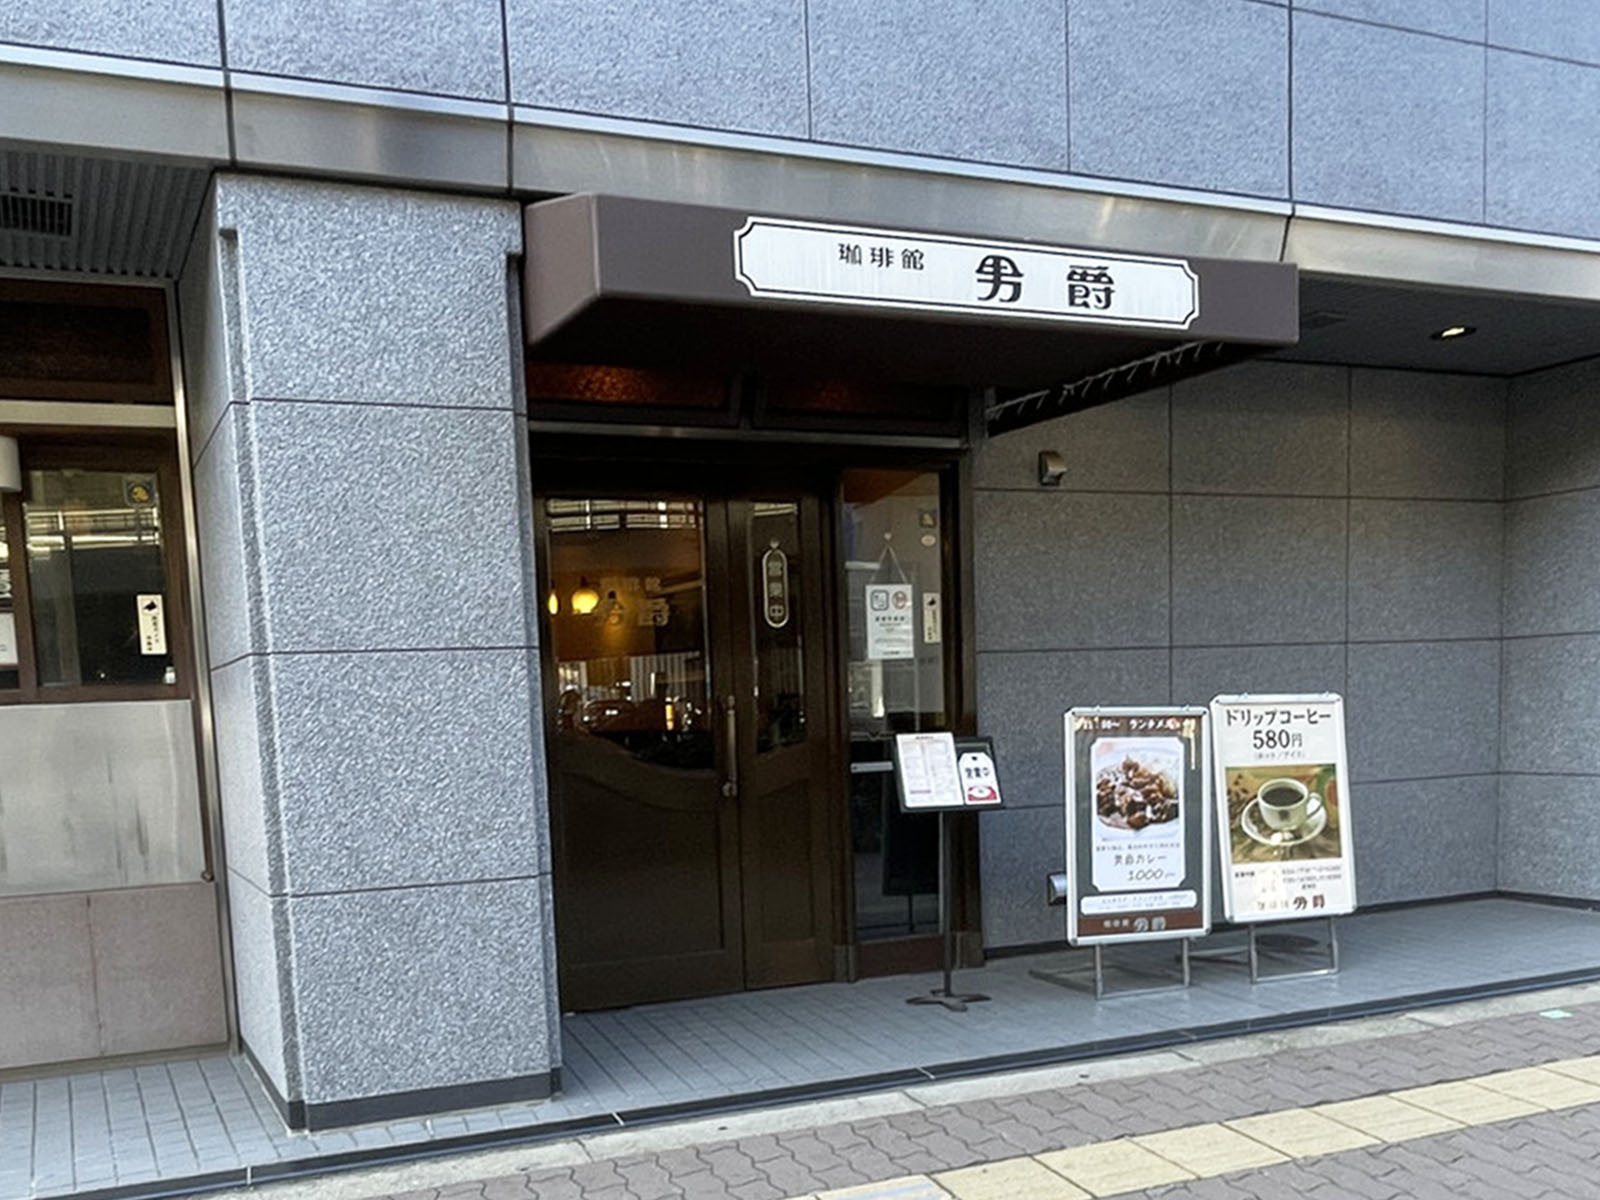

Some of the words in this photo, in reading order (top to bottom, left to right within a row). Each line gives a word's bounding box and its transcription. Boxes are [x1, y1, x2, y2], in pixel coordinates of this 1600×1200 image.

[838, 243, 925, 271] 珈琲館
[975, 255, 1115, 310] 男爵
[1225, 708, 1332, 727] ドリップコーヒー
[1252, 729, 1302, 750] 580円
